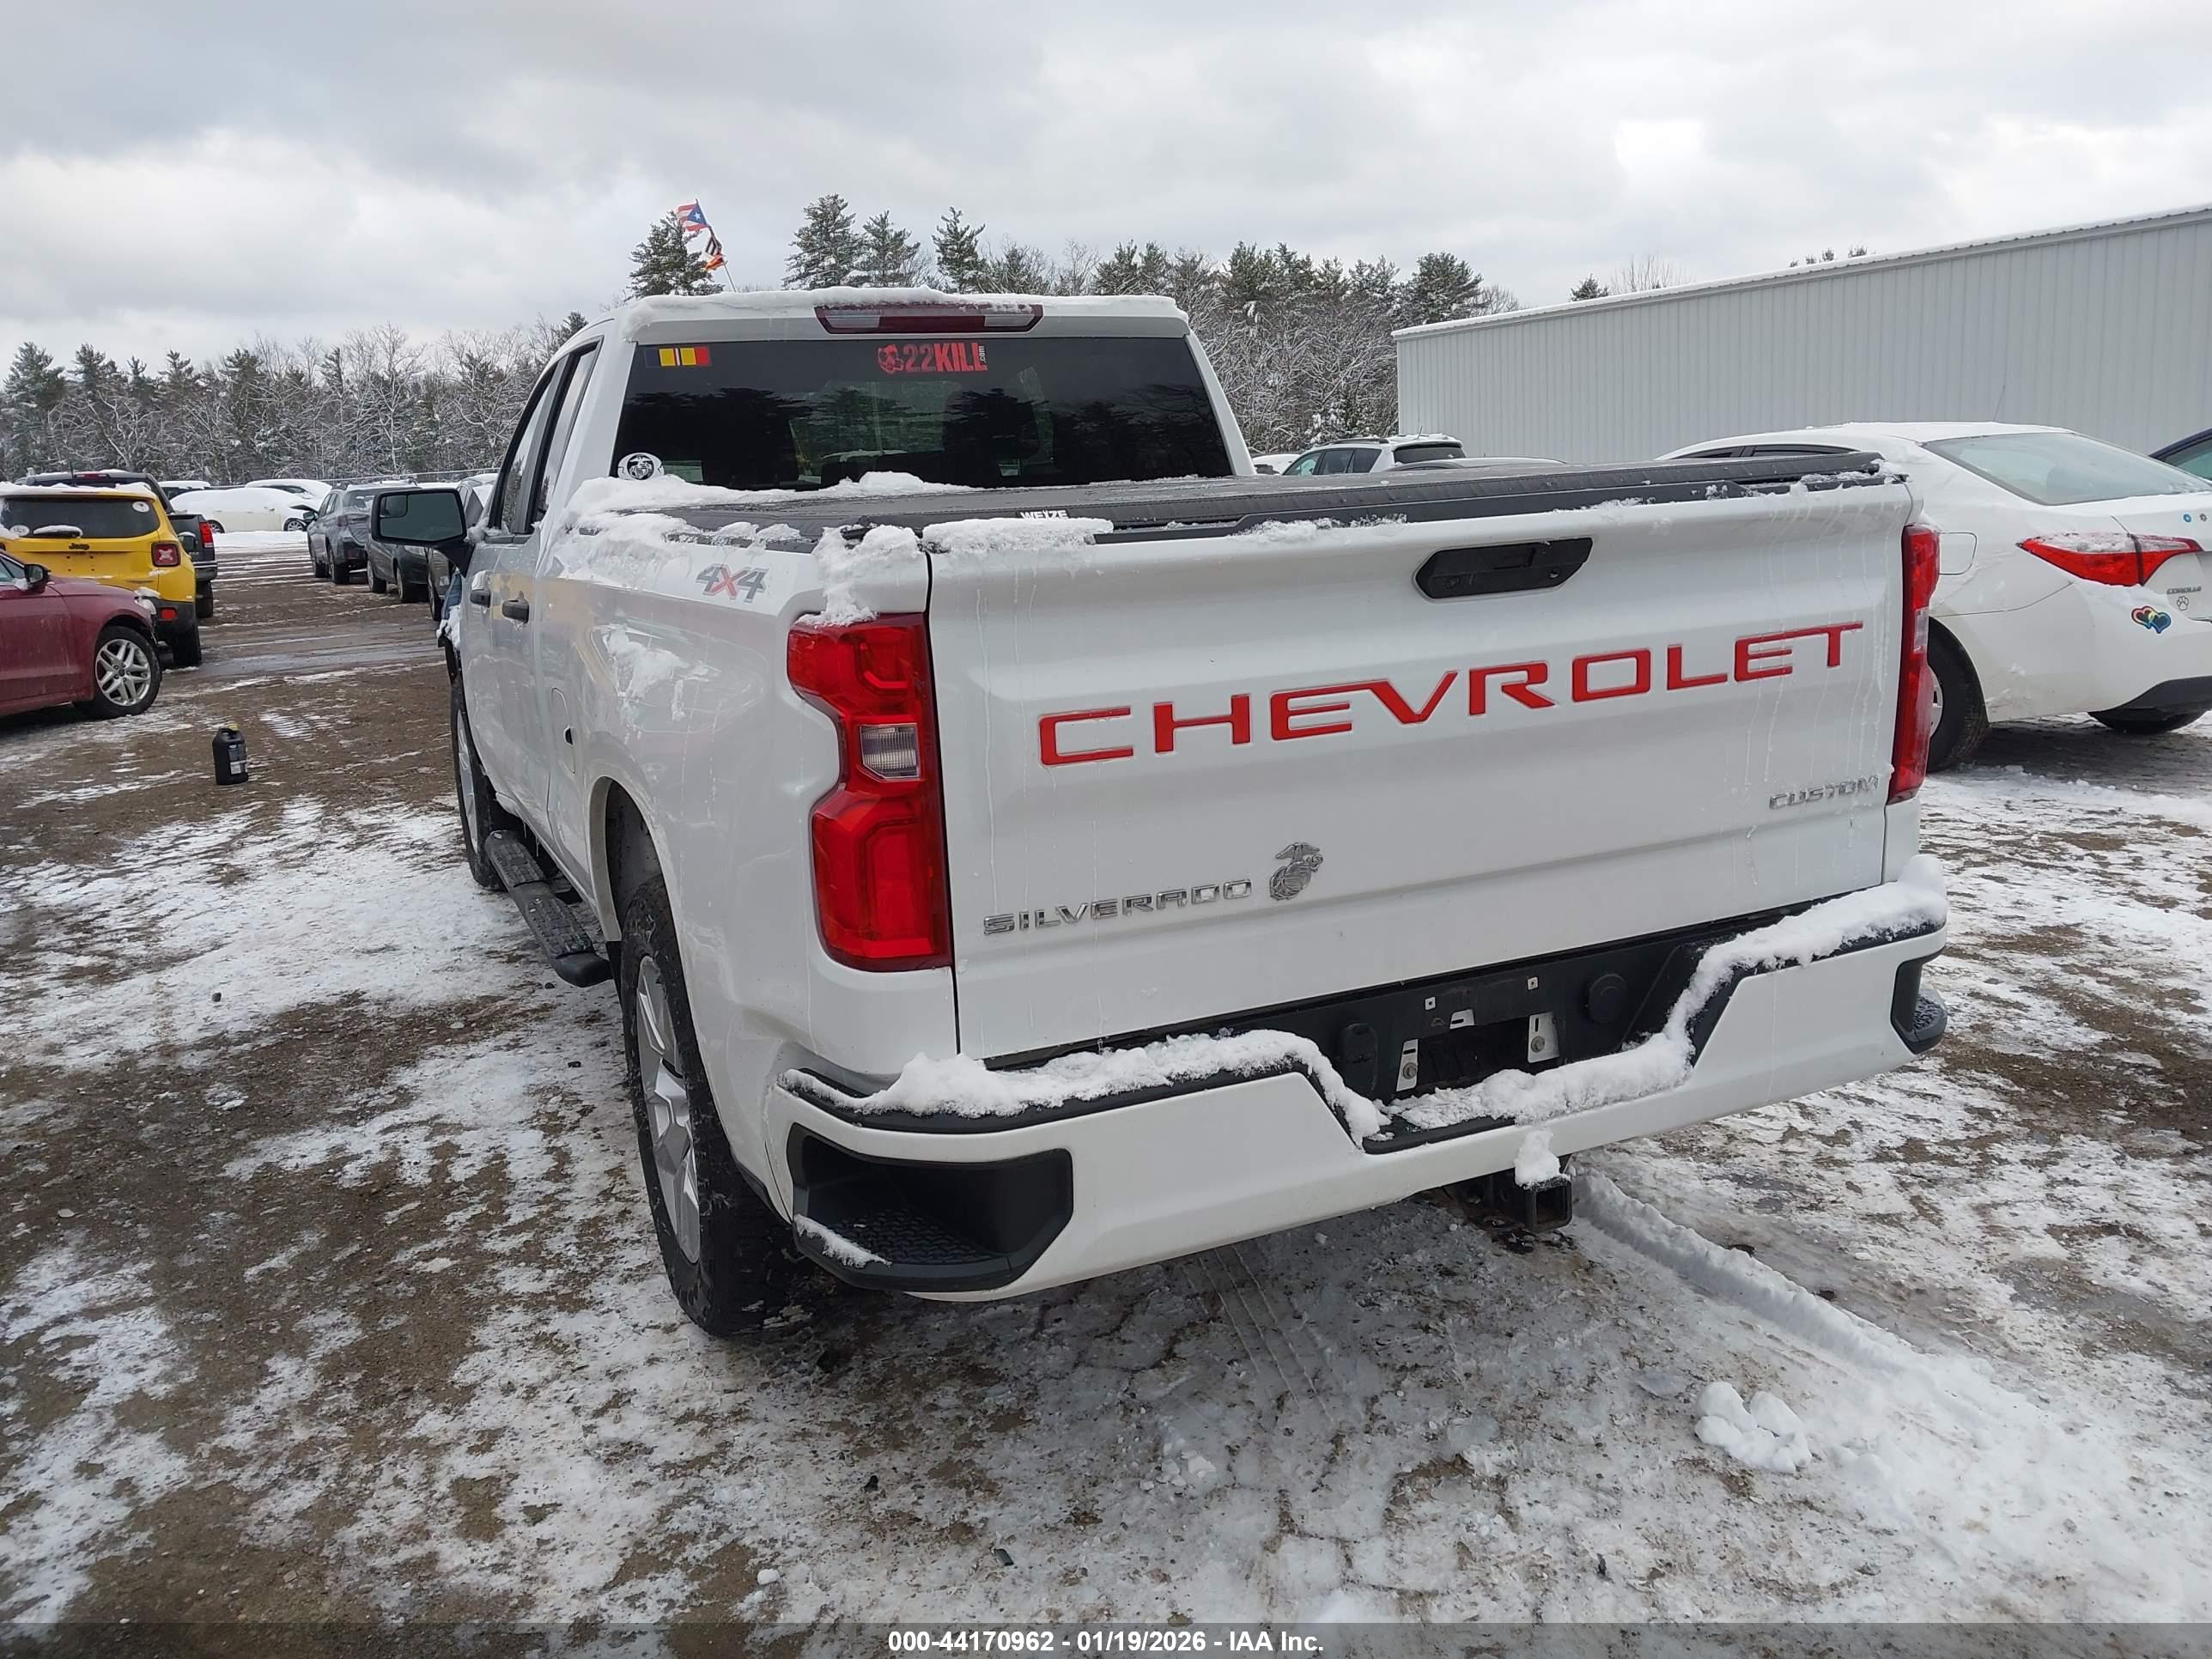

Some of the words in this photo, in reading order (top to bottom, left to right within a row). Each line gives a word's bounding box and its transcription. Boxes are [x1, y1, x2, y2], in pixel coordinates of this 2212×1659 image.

[1038, 620, 1864, 767] CHEVROLET
[1769, 775, 1879, 810] CUSTOM
[983, 878, 1252, 935] SILVERADO
